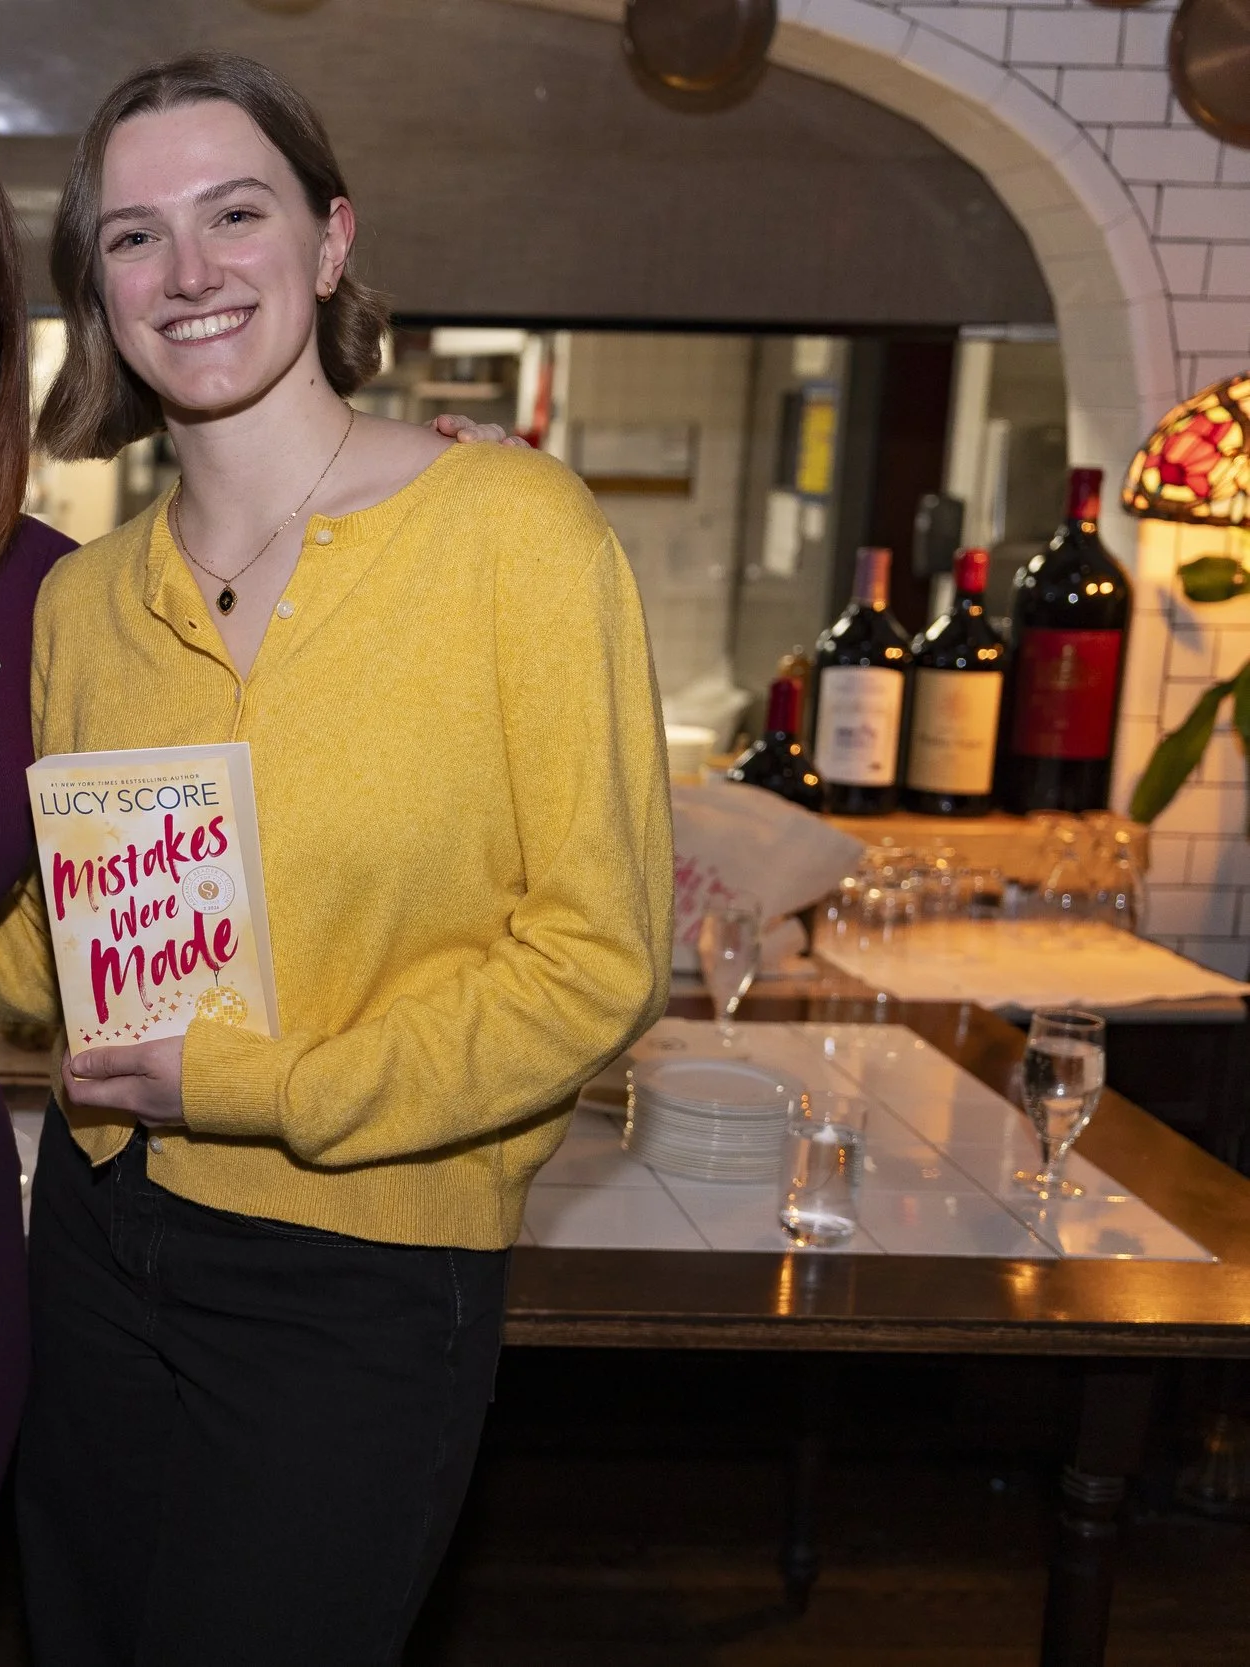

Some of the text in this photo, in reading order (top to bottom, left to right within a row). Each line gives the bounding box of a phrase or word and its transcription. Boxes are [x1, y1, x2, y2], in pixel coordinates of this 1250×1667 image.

[39, 782, 220, 816] LUCY SCORE
[120, 777, 168, 785] BESTSELLING
[170, 773, 200, 782] AUTHOR
[52, 813, 229, 921] Mistakes
[110, 894, 180, 942] Were
[90, 912, 239, 1025] Made
